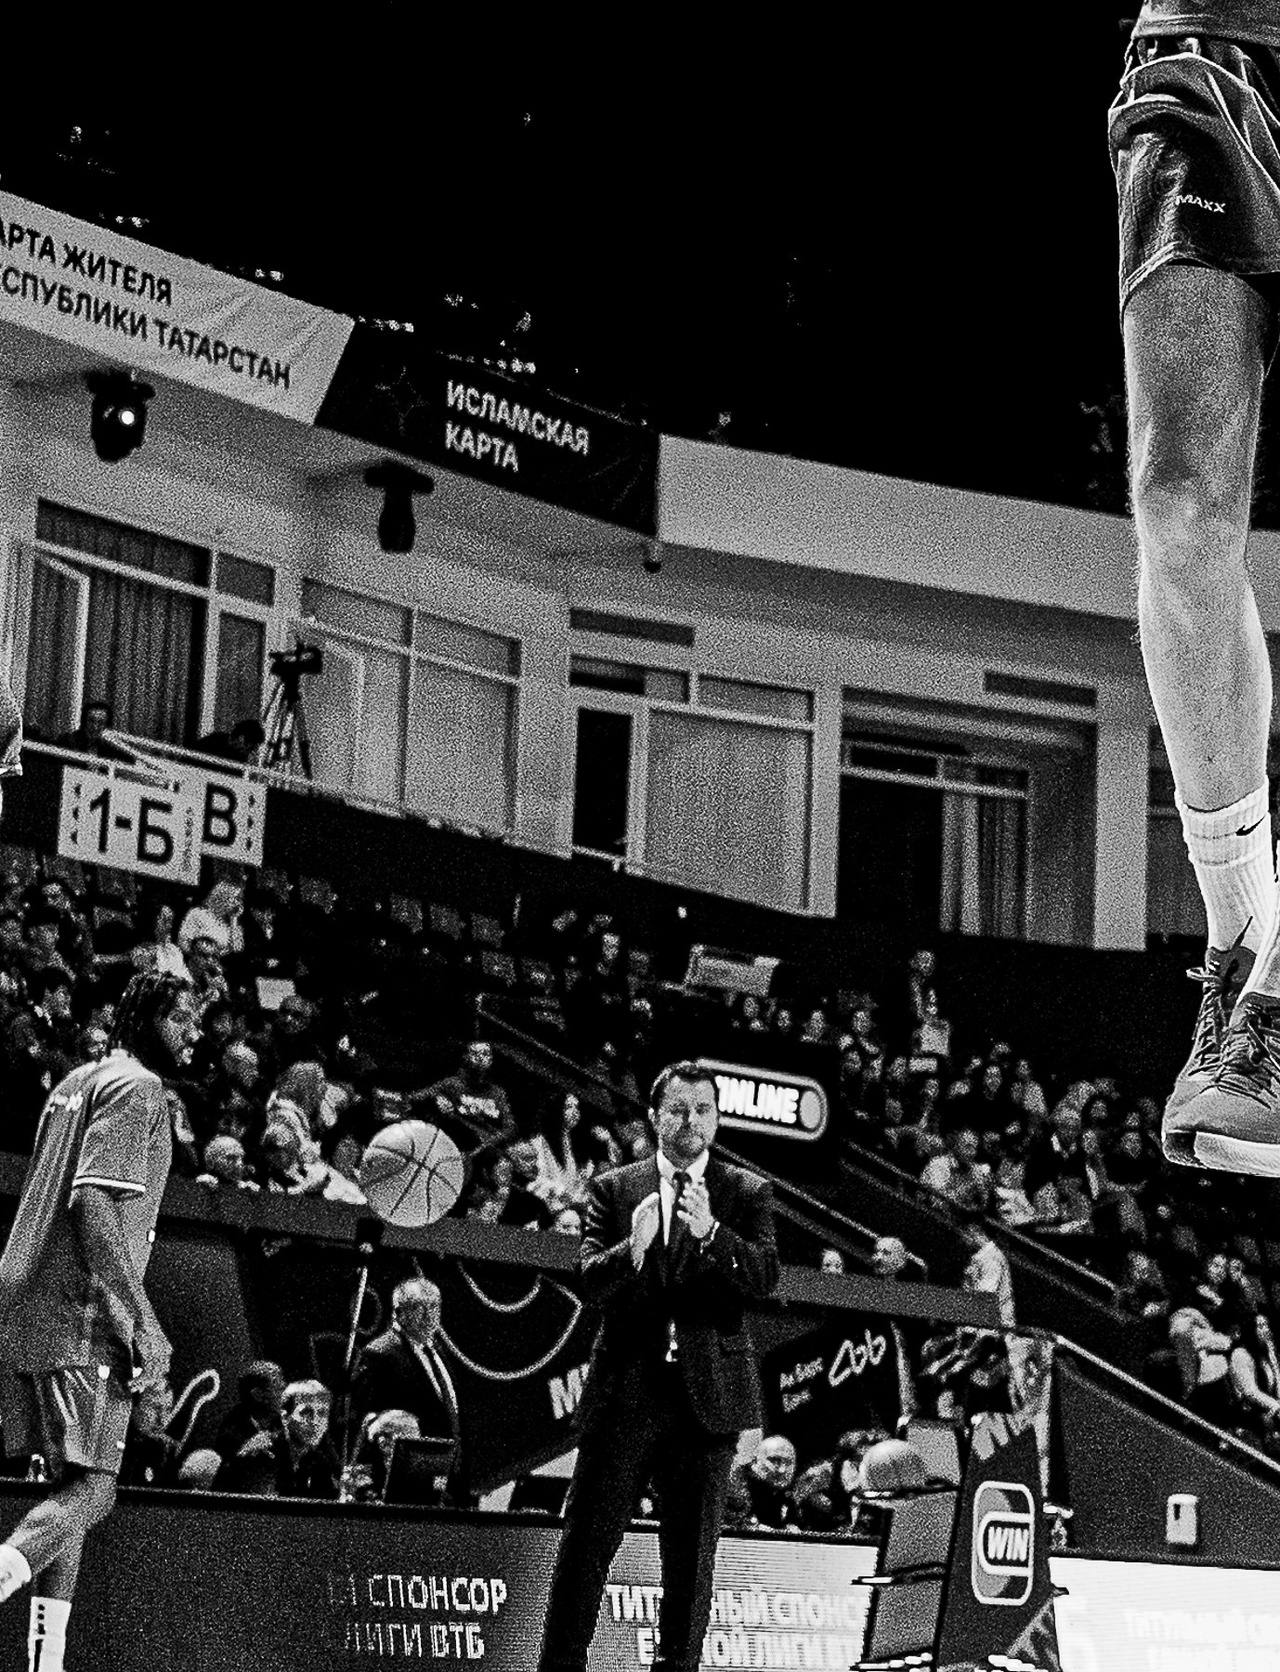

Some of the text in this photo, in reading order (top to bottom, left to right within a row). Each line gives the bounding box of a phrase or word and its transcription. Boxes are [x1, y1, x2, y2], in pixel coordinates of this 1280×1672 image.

[62, 242, 172, 307] ЖИТЕЛЯ
[152, 318, 291, 390] ТАТАРСТАН
[446, 379, 590, 456] ИСЛАМСКАЯ
[445, 420, 519, 473] КАРТА
[89, 787, 174, 866] 1-Б
[714, 1075, 799, 1124] INLINE
[987, 1526, 1029, 1562] WIN
[368, 1574, 508, 1615] СПОНСОР
[430, 1622, 486, 1660] ВТБ
